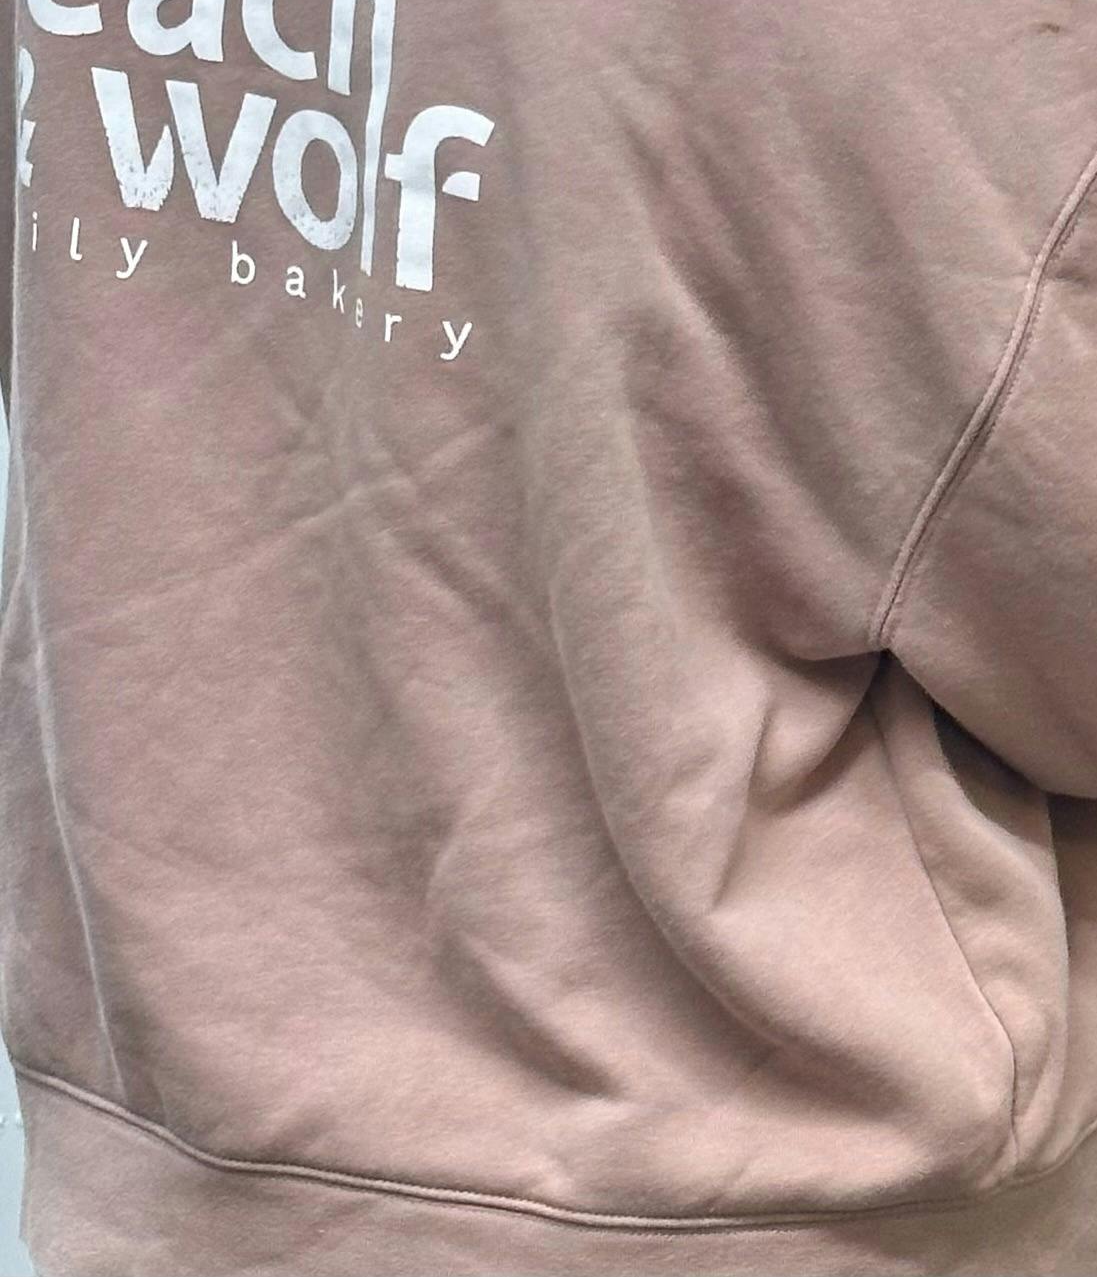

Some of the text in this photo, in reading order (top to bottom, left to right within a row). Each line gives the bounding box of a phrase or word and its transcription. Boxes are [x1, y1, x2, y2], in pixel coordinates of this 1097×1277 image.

[90, 66, 496, 292] wolf
[30, 212, 473, 361] ily bakery
